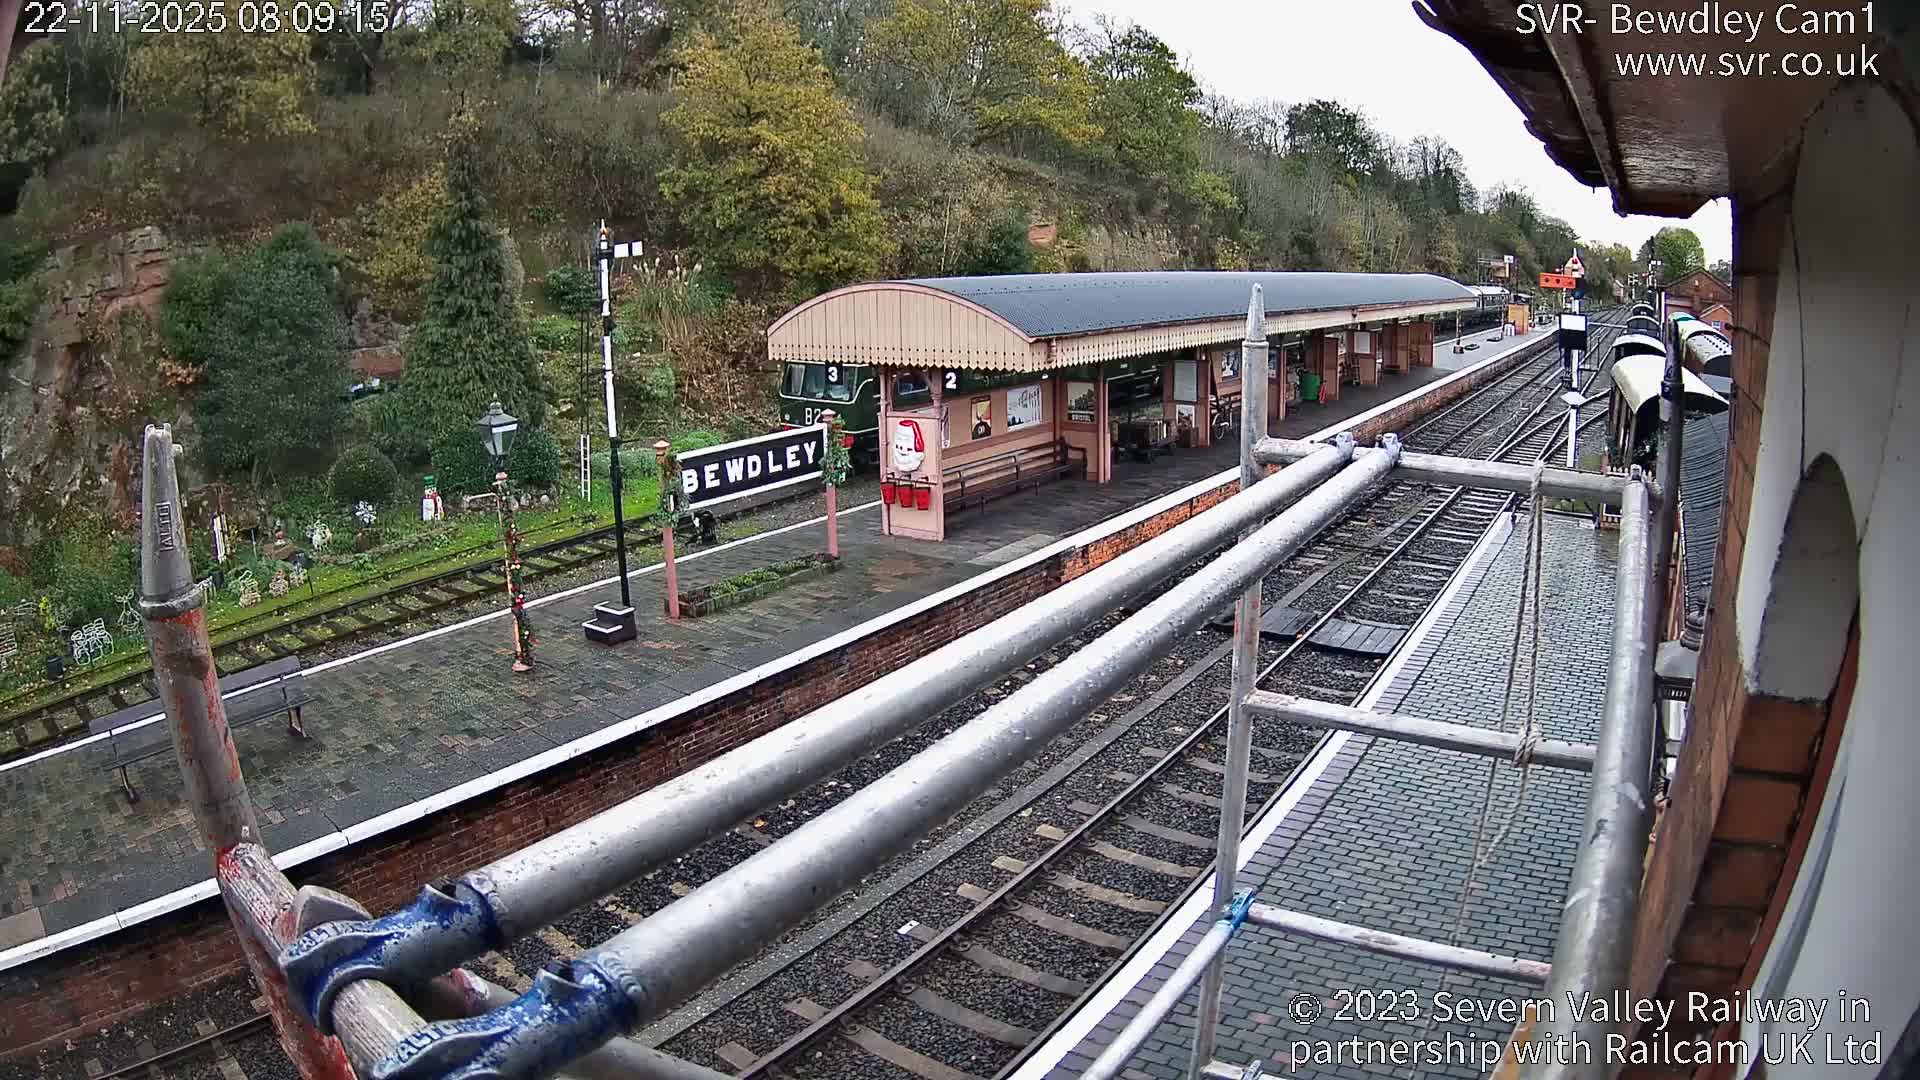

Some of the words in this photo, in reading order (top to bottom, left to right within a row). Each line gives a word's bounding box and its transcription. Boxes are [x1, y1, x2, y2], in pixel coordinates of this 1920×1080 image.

[827, 366, 839, 383] 3
[945, 371, 958, 389] 2
[682, 440, 817, 494] BEWDLEY
